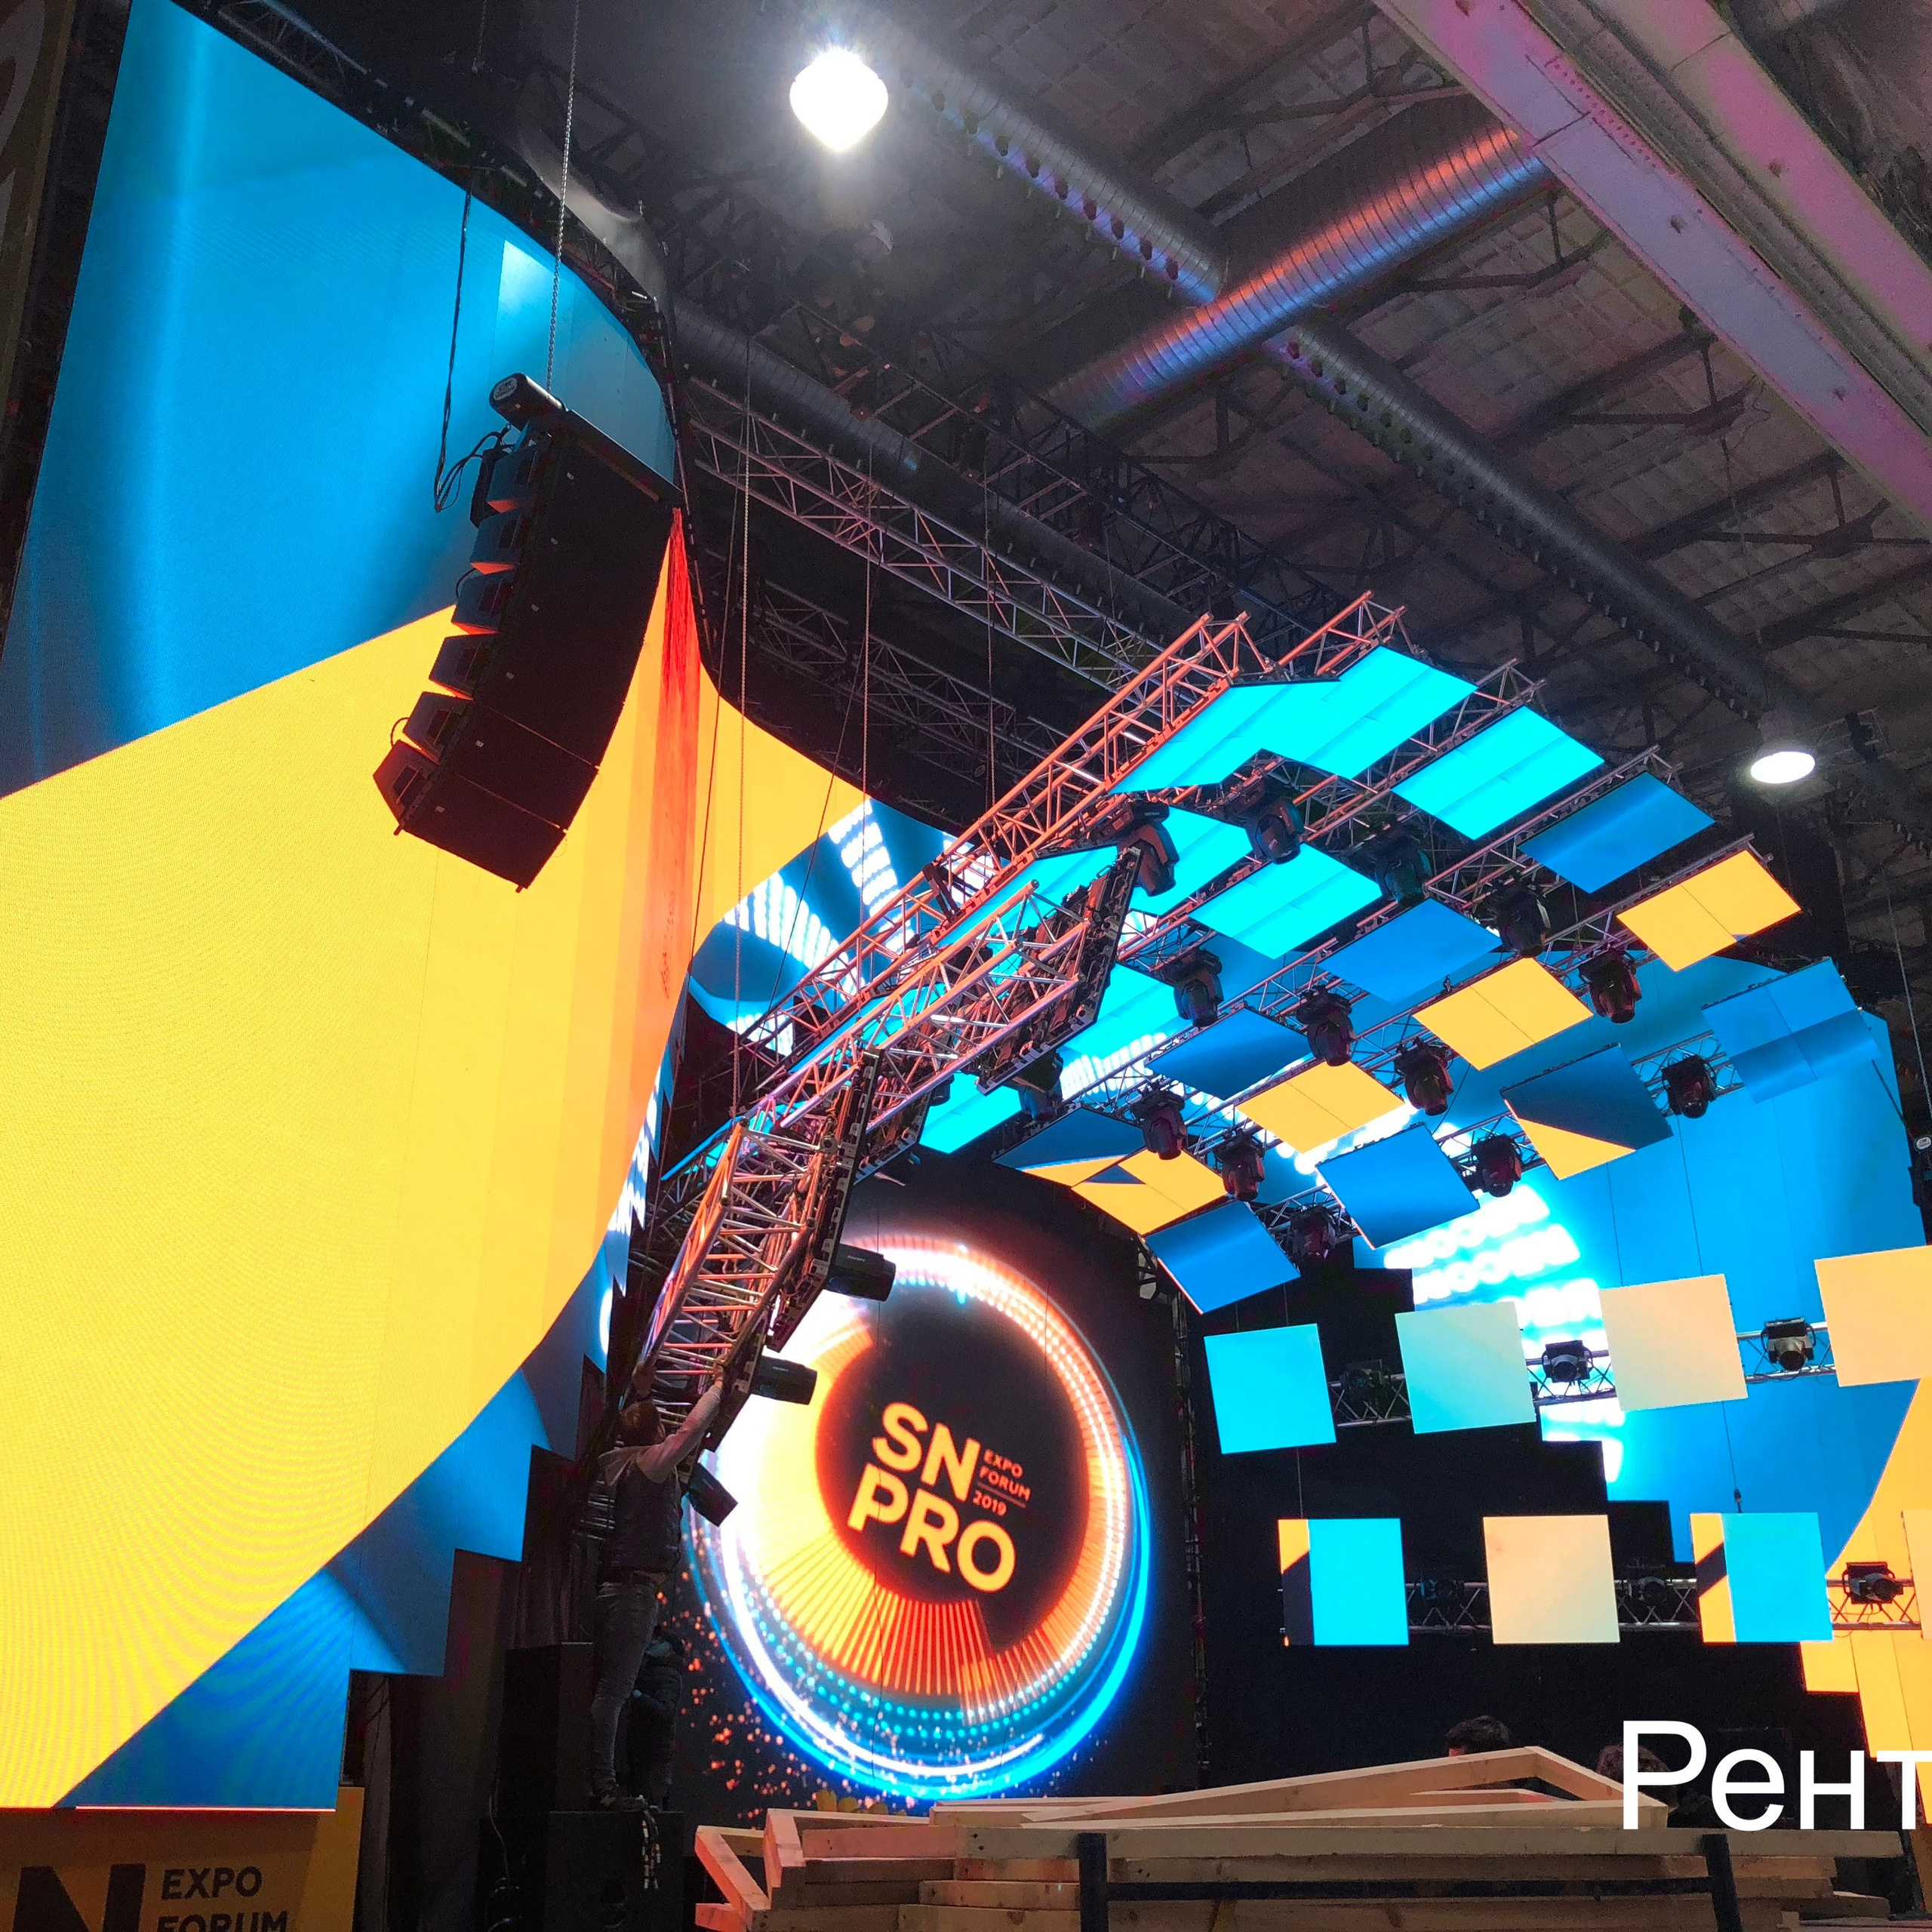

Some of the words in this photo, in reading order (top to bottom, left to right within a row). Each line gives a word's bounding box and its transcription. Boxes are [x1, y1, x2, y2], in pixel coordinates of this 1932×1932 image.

[872, 1401, 981, 1502] SN
[983, 1449, 1023, 1479] EXPO
[979, 1466, 1032, 1501] FORUM
[972, 1489, 1008, 1517] 2019
[847, 1462, 1017, 1593] PRO
[161, 1866, 263, 1901] EXPO
[156, 1911, 288, 1932] FORUM
